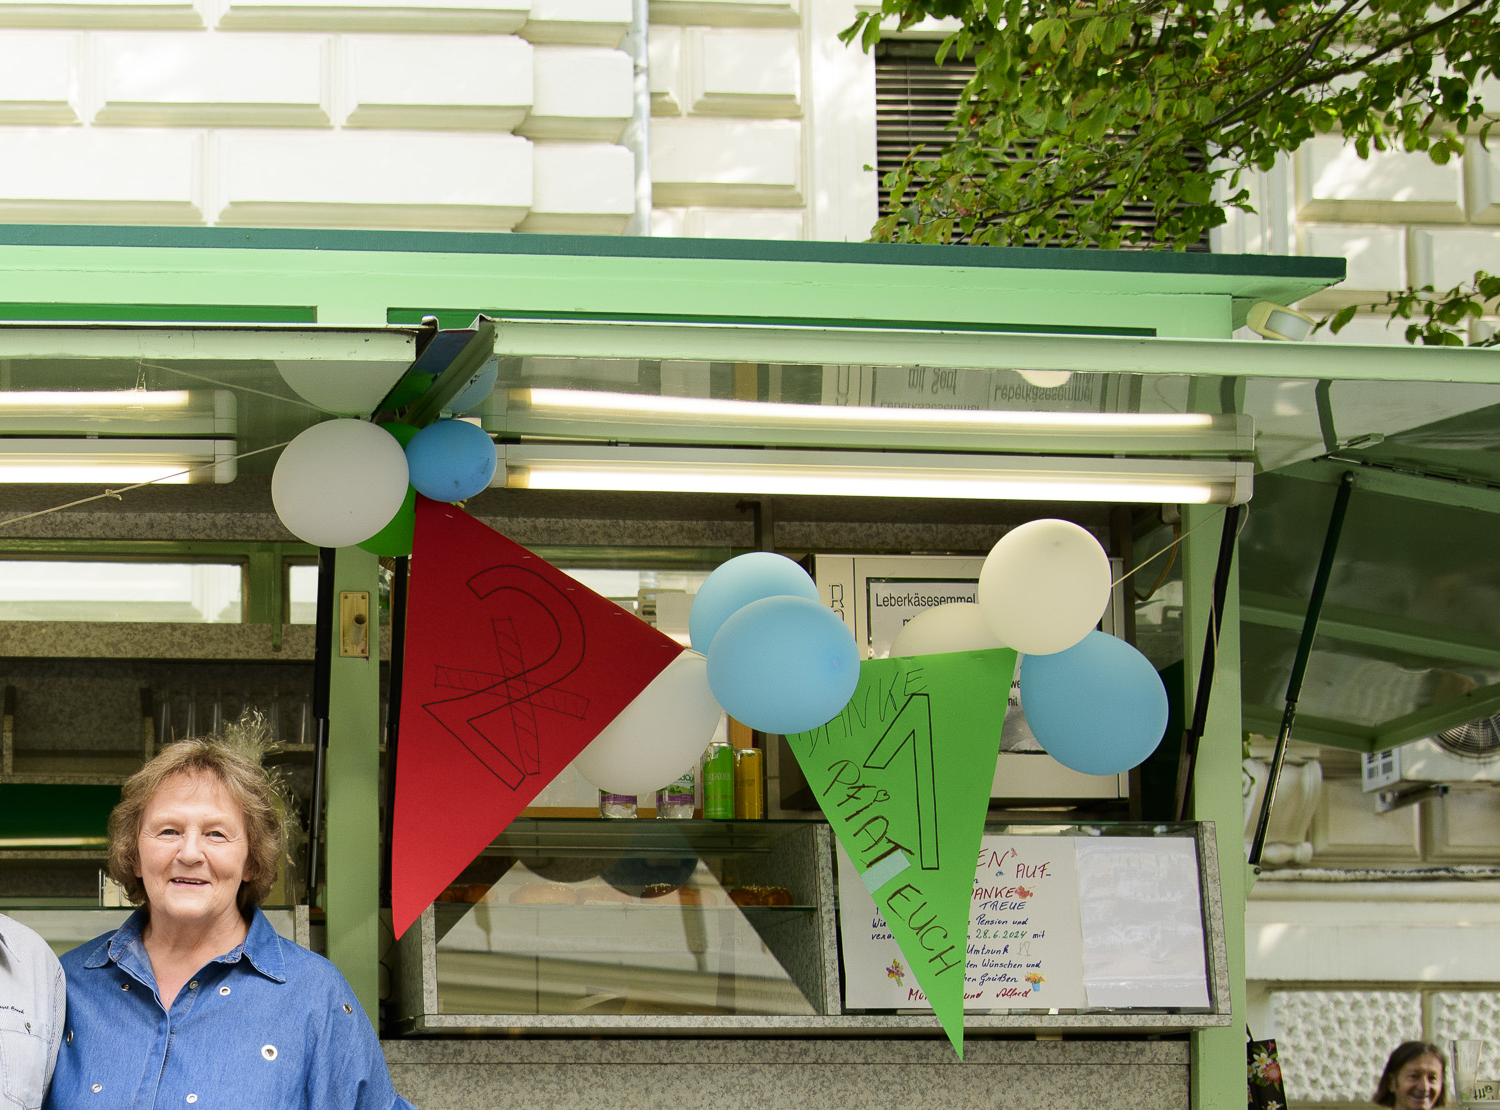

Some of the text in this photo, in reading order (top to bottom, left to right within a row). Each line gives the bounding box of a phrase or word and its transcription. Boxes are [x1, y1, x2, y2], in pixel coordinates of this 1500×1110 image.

[971, 886, 1016, 900] ANKE
[979, 900, 1026, 911] TREUE
[975, 914, 1008, 926] Pension
[1012, 917, 1029, 926] und
[885, 883, 962, 976] EUCH
[975, 928, 1045, 939] 28.6.2024 mit
[966, 944, 1010, 955] Umtrunk
[982, 958, 1022, 969] Wünschen
[1026, 960, 1041, 969] und
[978, 973, 1018, 986] Grüßen
[964, 991, 983, 1000] und
